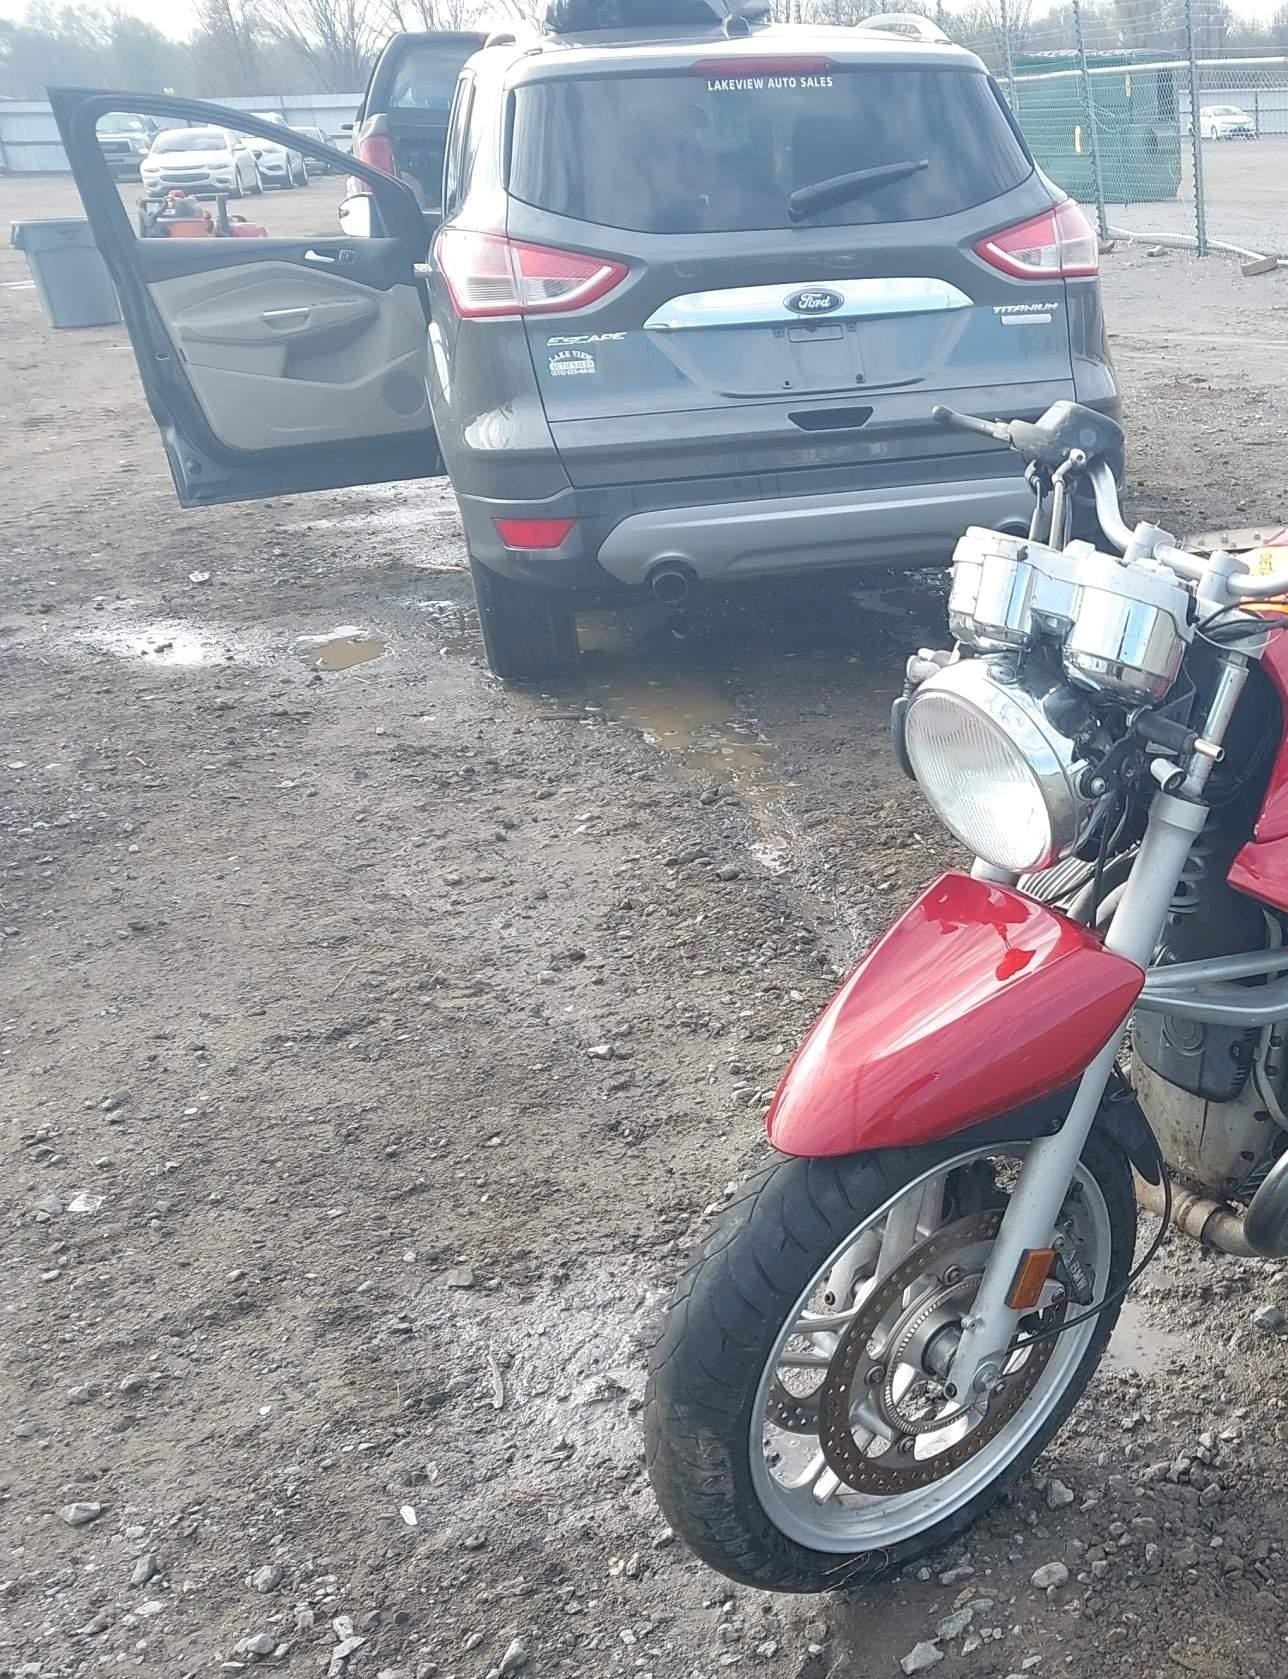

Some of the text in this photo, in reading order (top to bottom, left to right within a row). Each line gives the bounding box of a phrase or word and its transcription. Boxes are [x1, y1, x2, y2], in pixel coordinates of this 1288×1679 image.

[707, 76, 833, 91] LAKEVIEW AUTO SALES
[798, 293, 831, 309] Ford
[992, 302, 1059, 314] TITANIUM
[546, 331, 628, 347] ESCAPE
[548, 350, 571, 363] LAKE
[1070, 1260, 1088, 1291] BMW
